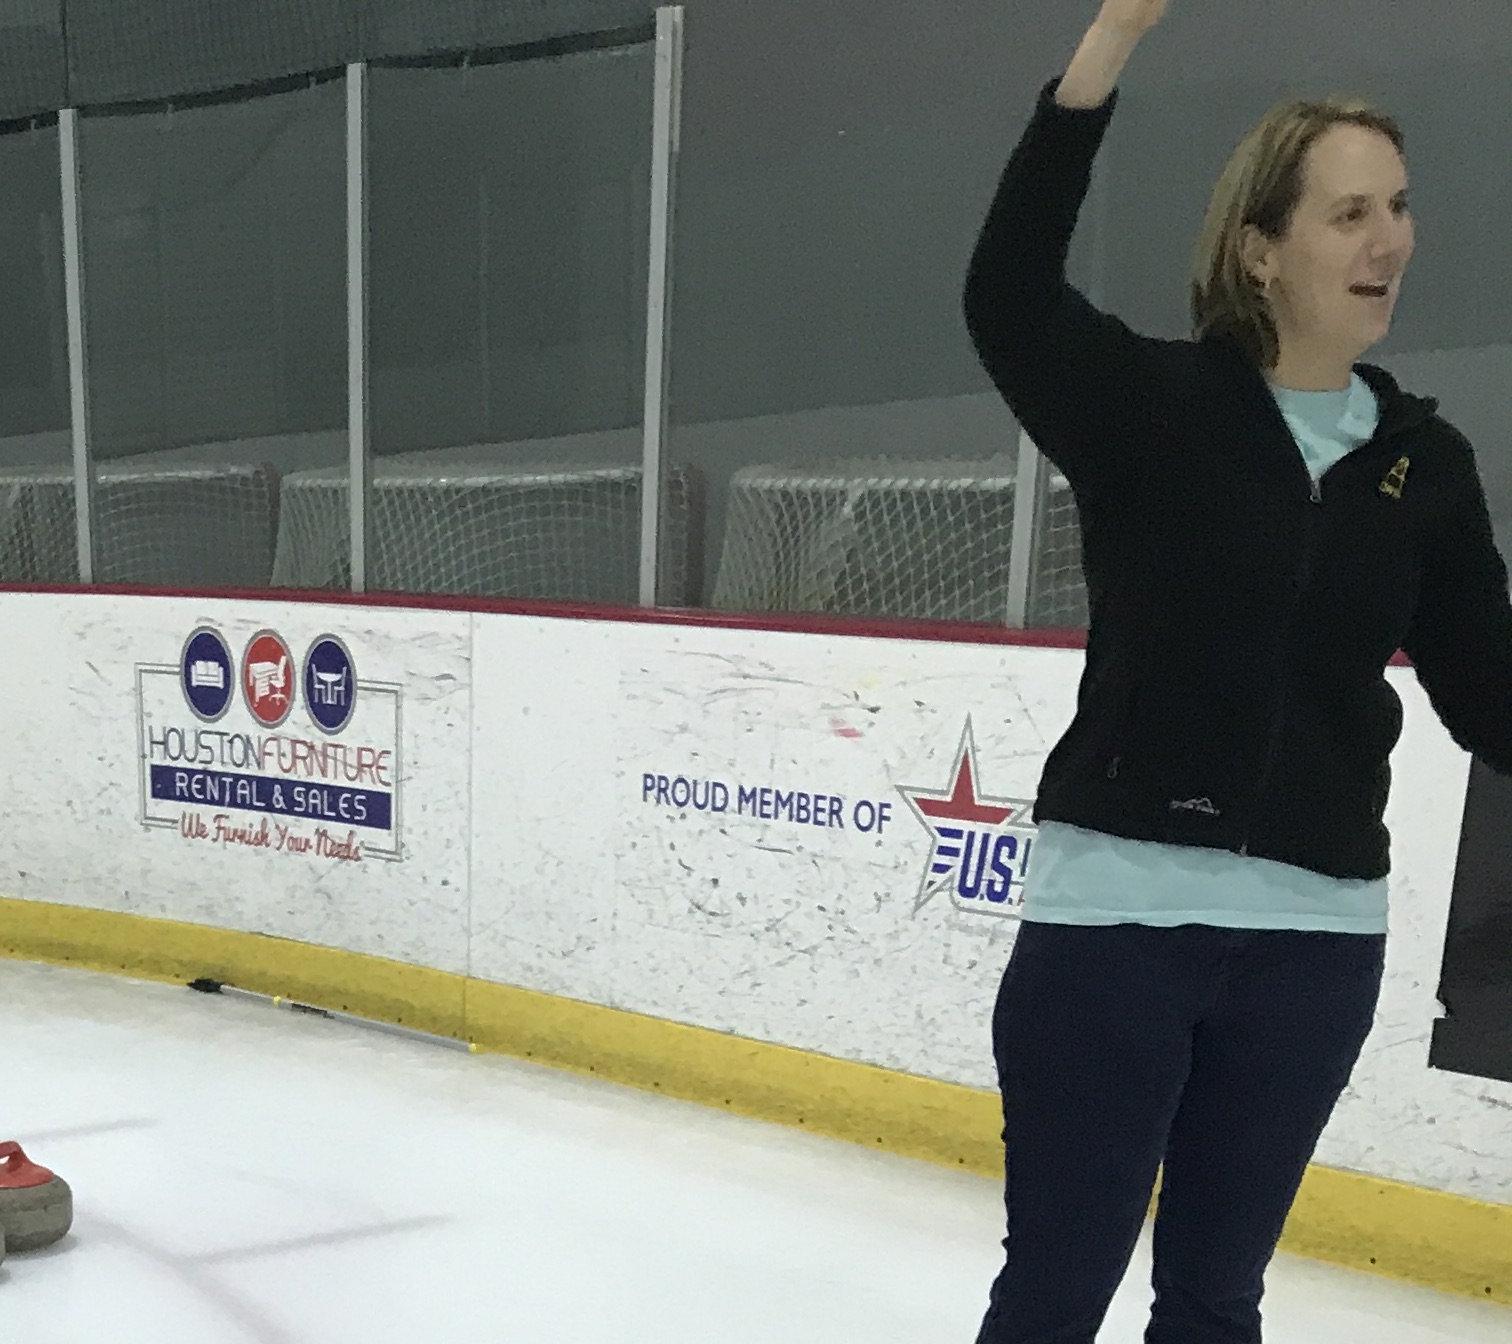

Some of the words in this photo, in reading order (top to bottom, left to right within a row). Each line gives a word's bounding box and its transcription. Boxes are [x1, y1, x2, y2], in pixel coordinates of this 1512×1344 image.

[175, 773, 266, 808] RENTAL
[272, 784, 288, 811] &
[292, 790, 367, 821] SALES
[642, 773, 728, 812] PROUD
[738, 784, 845, 829] MEMBER
[853, 799, 892, 834] OF
[181, 811, 209, 841] We
[211, 813, 271, 848] Furnish
[274, 820, 313, 854] Your
[314, 828, 362, 862] Needs
